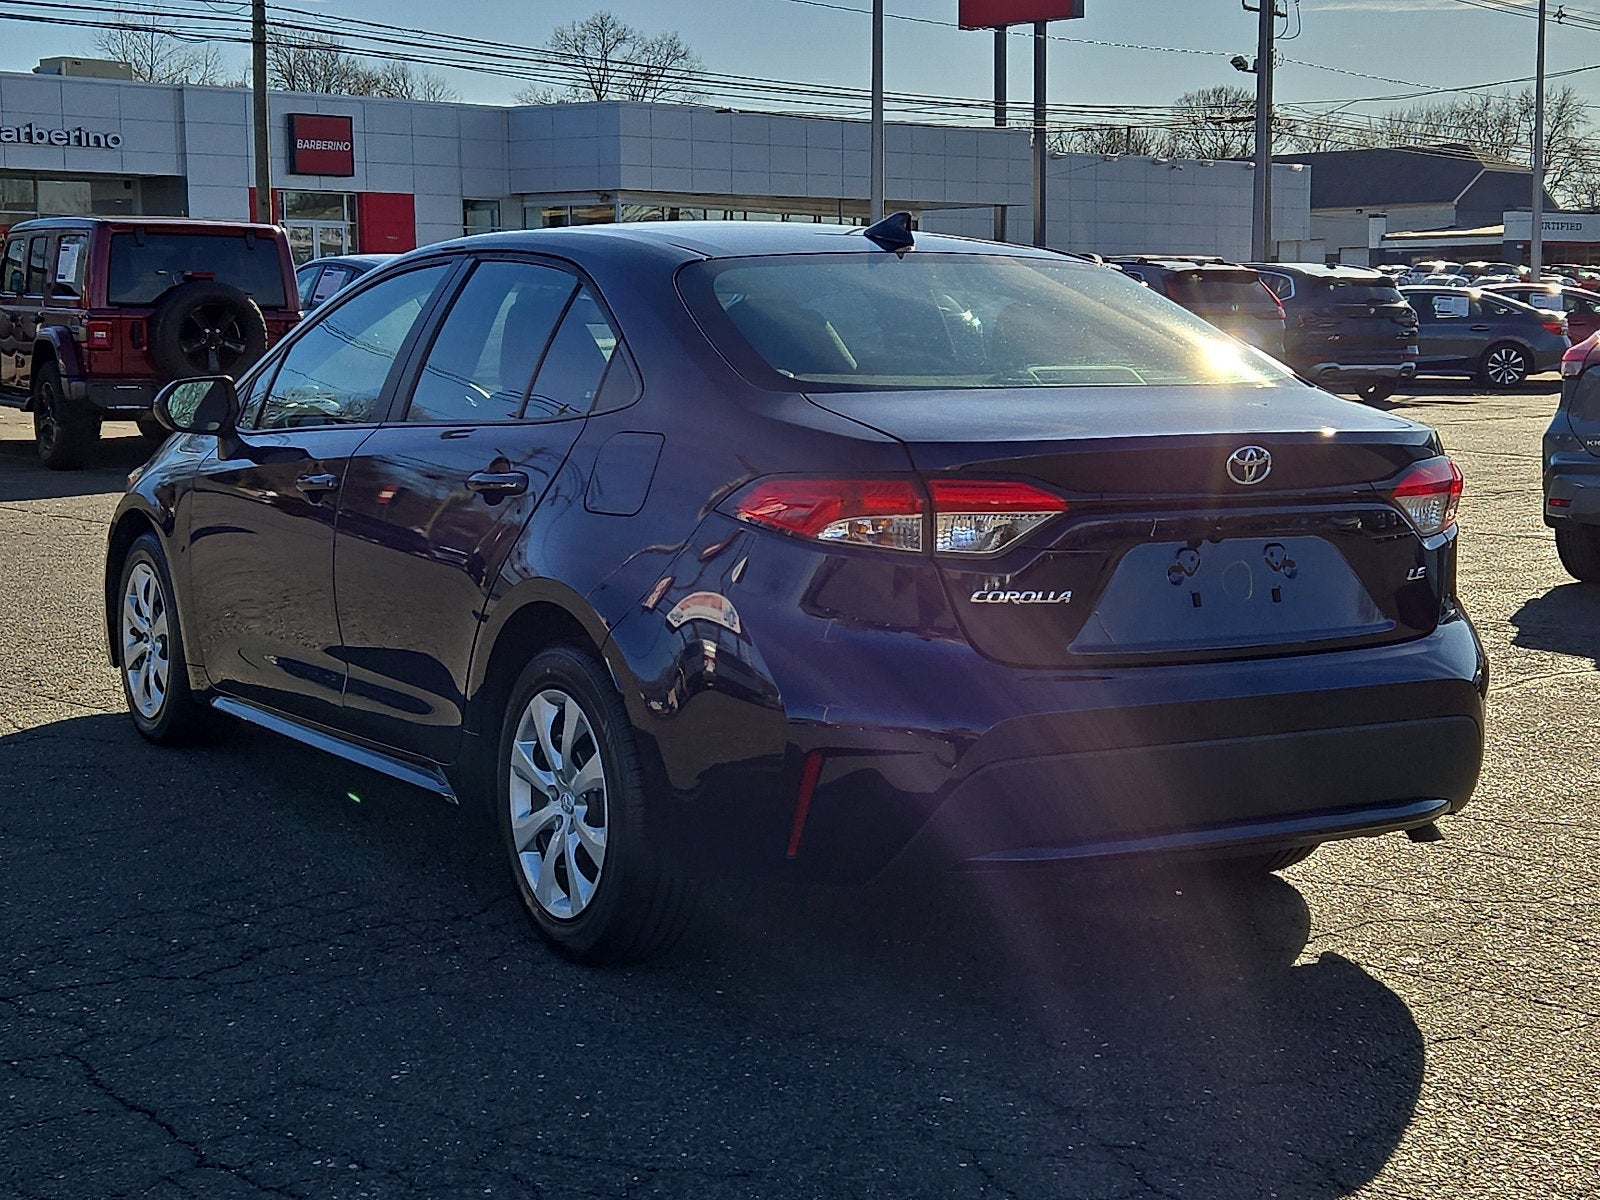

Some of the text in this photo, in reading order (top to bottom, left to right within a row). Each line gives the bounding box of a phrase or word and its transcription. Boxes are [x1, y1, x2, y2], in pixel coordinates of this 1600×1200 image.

[0, 122, 123, 149] arberino
[296, 139, 351, 151] BARBERINO
[1541, 221, 1583, 231] RTIFIED
[1406, 566, 1427, 581] LE
[970, 590, 1072, 605] COROLLA
